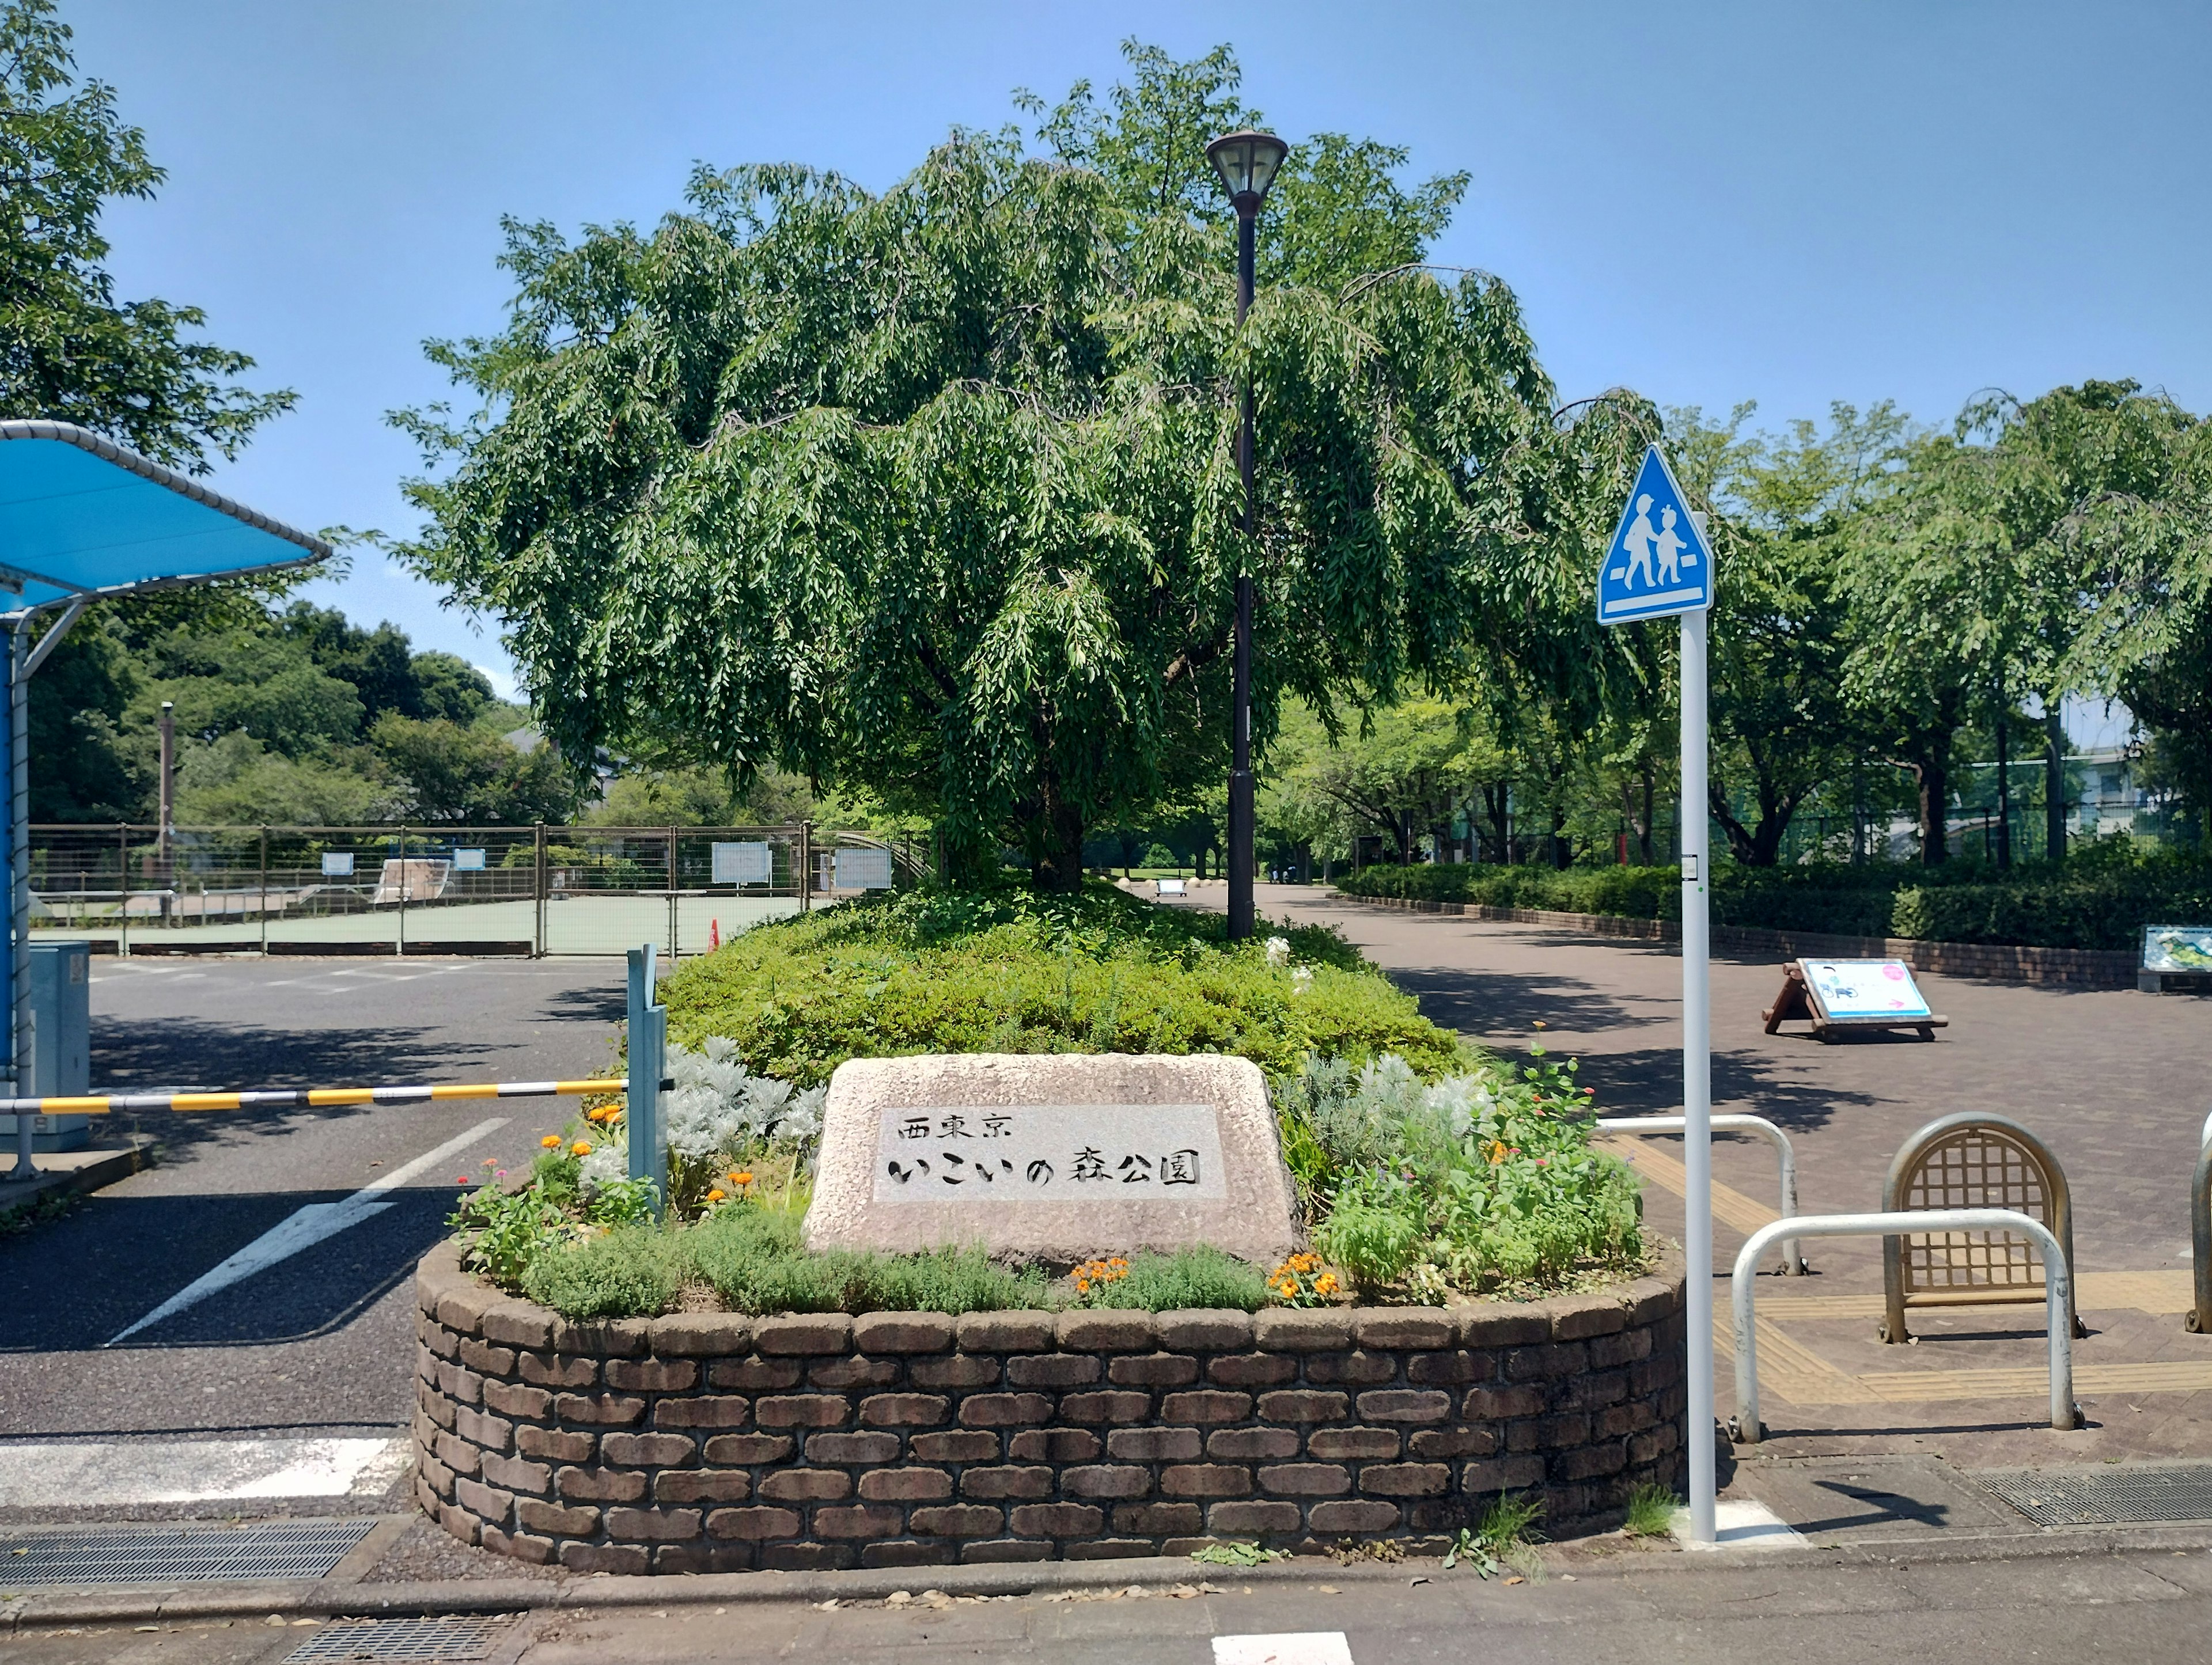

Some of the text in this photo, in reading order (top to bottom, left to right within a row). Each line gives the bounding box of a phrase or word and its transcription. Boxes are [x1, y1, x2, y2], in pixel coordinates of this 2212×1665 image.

[898, 1113, 1012, 1139] 西東京
[888, 1147, 1199, 1186] いこいの森公園
